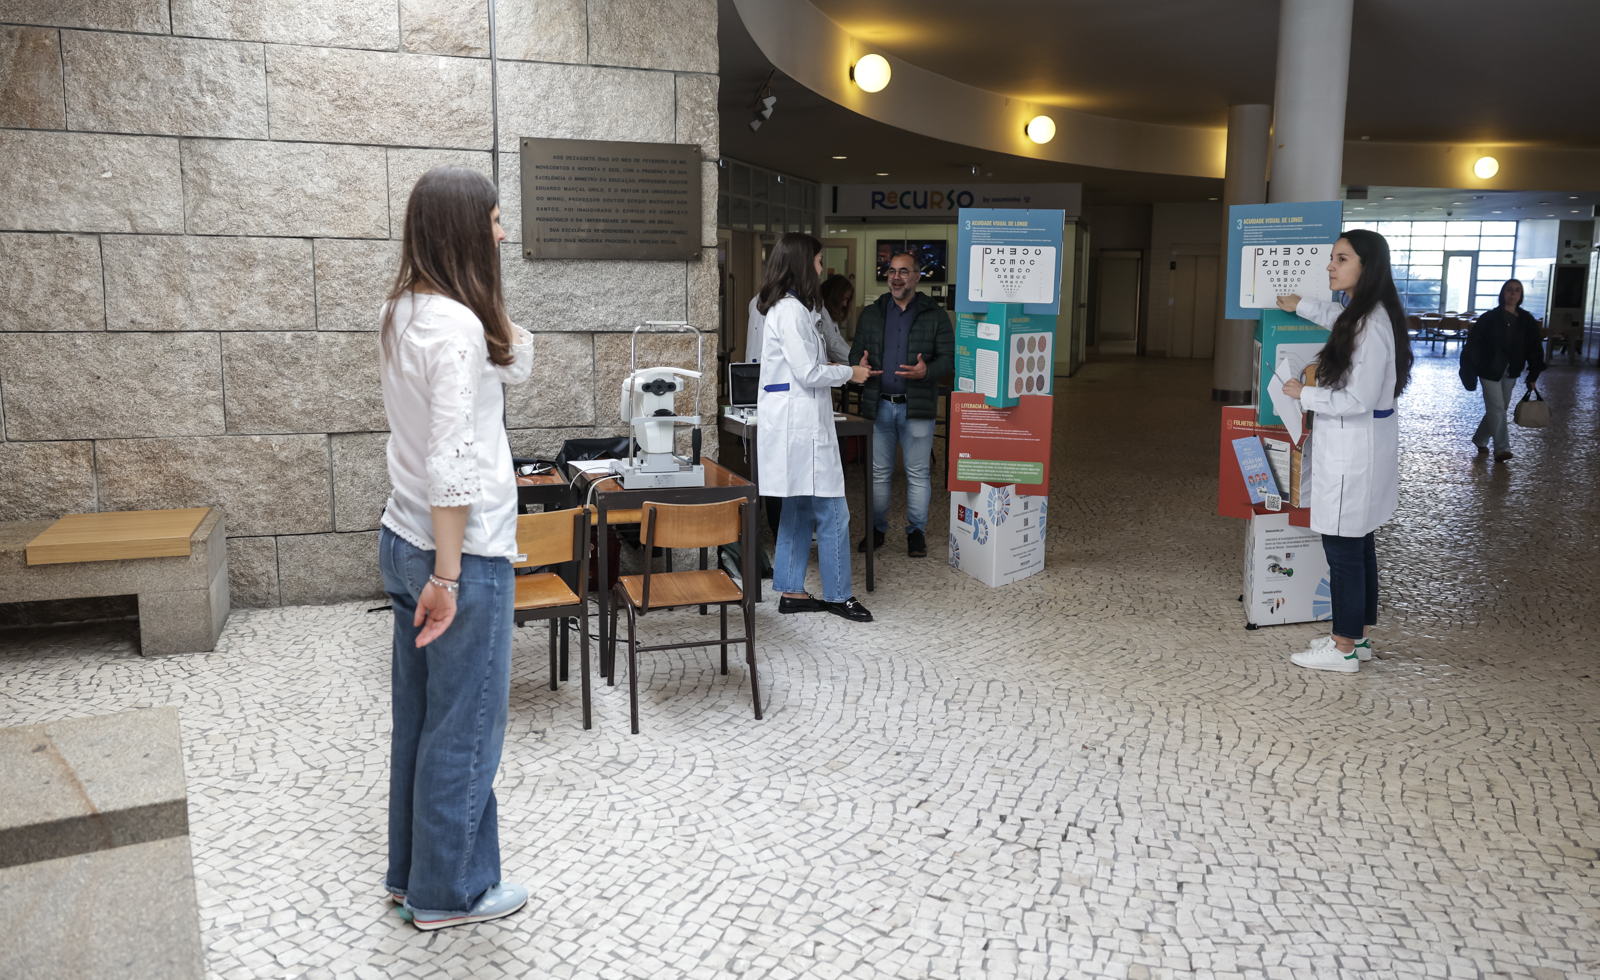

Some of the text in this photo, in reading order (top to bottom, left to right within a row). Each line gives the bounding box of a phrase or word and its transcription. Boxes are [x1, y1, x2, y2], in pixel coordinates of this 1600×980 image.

[965, 220, 971, 230] 3
[1236, 219, 1242, 230] 3
[1271, 326, 1276, 336] 7
[955, 403, 960, 412] 8
[1227, 419, 1232, 429] 9
